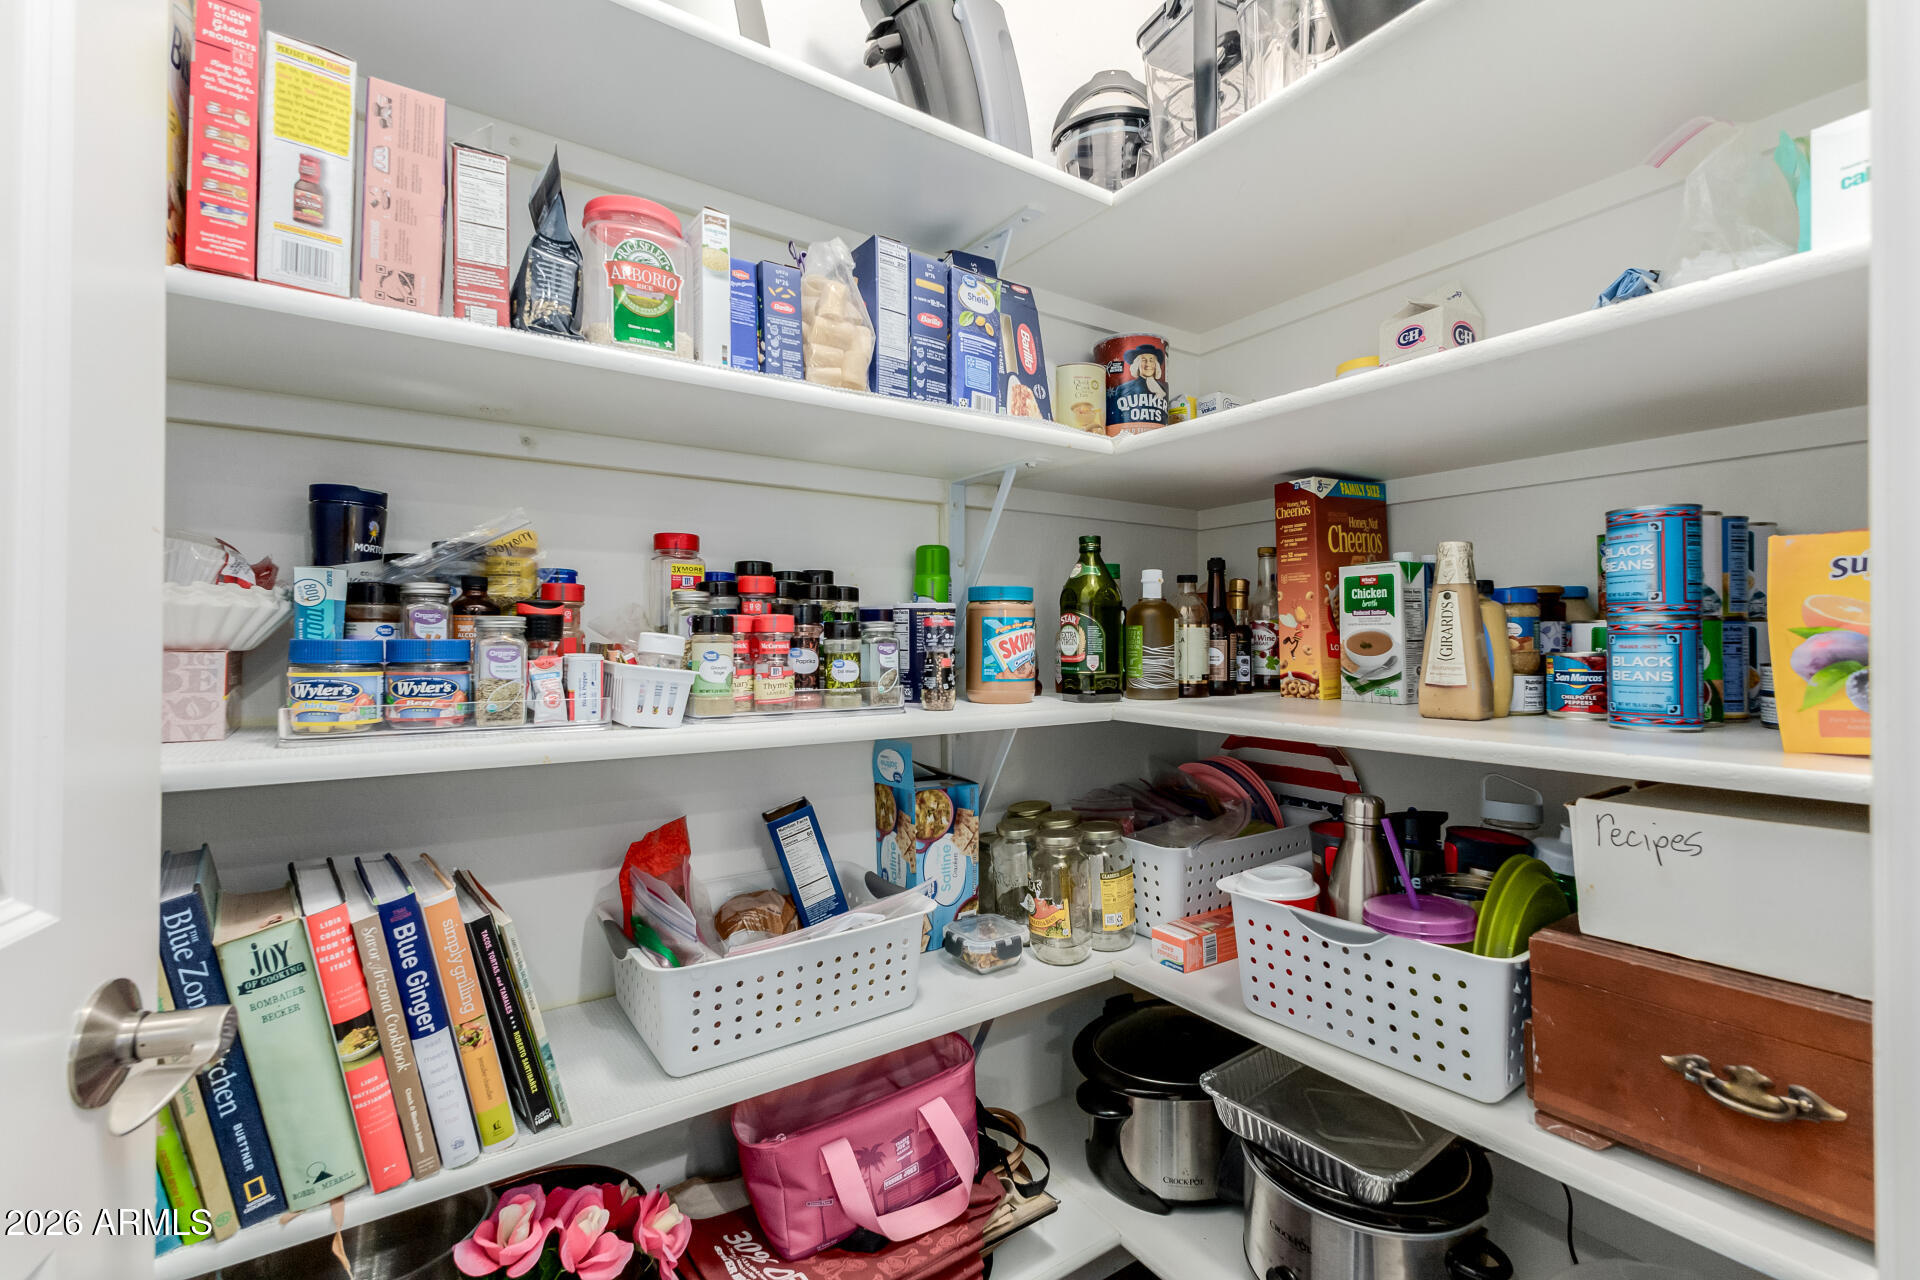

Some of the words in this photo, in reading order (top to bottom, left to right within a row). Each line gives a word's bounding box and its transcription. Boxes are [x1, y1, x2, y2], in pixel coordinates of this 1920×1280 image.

[207, 2, 227, 13] TRY
[229, 9, 252, 22] OUR
[213, 11, 246, 27] OTHER
[211, 18, 249, 39] Great
[202, 28, 257, 53] PRODUCTS
[611, 264, 678, 292] ARBORIO
[773, 303, 794, 313] Barilla
[967, 291, 989, 307] Shells
[920, 315, 941, 327] Barilla
[1020, 328, 1034, 372] Barilla
[1117, 393, 1168, 412] QUAKER
[1130, 408, 1163, 421] OATS
[1339, 481, 1366, 497] FAMILY
[1365, 484, 1380, 498] SIZE
[1275, 505, 1311, 520] Cheerios
[1348, 516, 1367, 530] Honey
[1368, 517, 1379, 530] Nut
[1327, 524, 1383, 554] Cheerios
[671, 565, 682, 574] 3X
[682, 565, 703, 573] MORE
[1351, 587, 1388, 599] Chicken
[1361, 599, 1378, 608] broth
[1060, 631, 1078, 640] EXTRA
[1439, 601, 1453, 658] GIRARD'S
[489, 650, 517, 658] Organic
[1612, 655, 1673, 667] BLACK
[1555, 672, 1571, 682] San
[1571, 672, 1602, 682] Marcos
[1612, 670, 1674, 682] BEANS
[293, 683, 356, 699] Wyler's
[397, 681, 454, 697] Wyler's
[763, 681, 789, 690] Thyme
[406, 699, 435, 707] Beef
[778, 822, 797, 833] Nutrition
[796, 816, 808, 826] Facts
[1596, 812, 1703, 865] recipes
[940, 843, 952, 893] Saltine
[163, 907, 194, 962] Blue
[190, 929, 200, 943] THE
[319, 926, 347, 941] COOKS
[442, 918, 466, 963] simply
[315, 941, 339, 953] FROM
[361, 926, 381, 960] Savor
[318, 949, 345, 963] HEART
[329, 958, 352, 973] ITALY
[481, 929, 493, 951] TACOS,
[487, 951, 501, 976] TORTAS,
[499, 986, 513, 1015] TAMALES
[178, 960, 210, 1009] Zon
[244, 980, 258, 990] OF
[260, 964, 304, 986] COOKING
[393, 921, 419, 970] Blue
[406, 969, 436, 1034] Ginger
[368, 960, 390, 1014] Arizona
[450, 964, 476, 1015] grilling
[249, 986, 306, 1012] ROMBAUER
[261, 1003, 301, 1024] BECKER
[384, 1013, 412, 1073] Cookbook
[513, 1030, 527, 1058] ROBERTO
[208, 1056, 238, 1119] chen
[233, 1121, 255, 1172] BUETTNER
[722, 1230, 779, 1264] 30%
